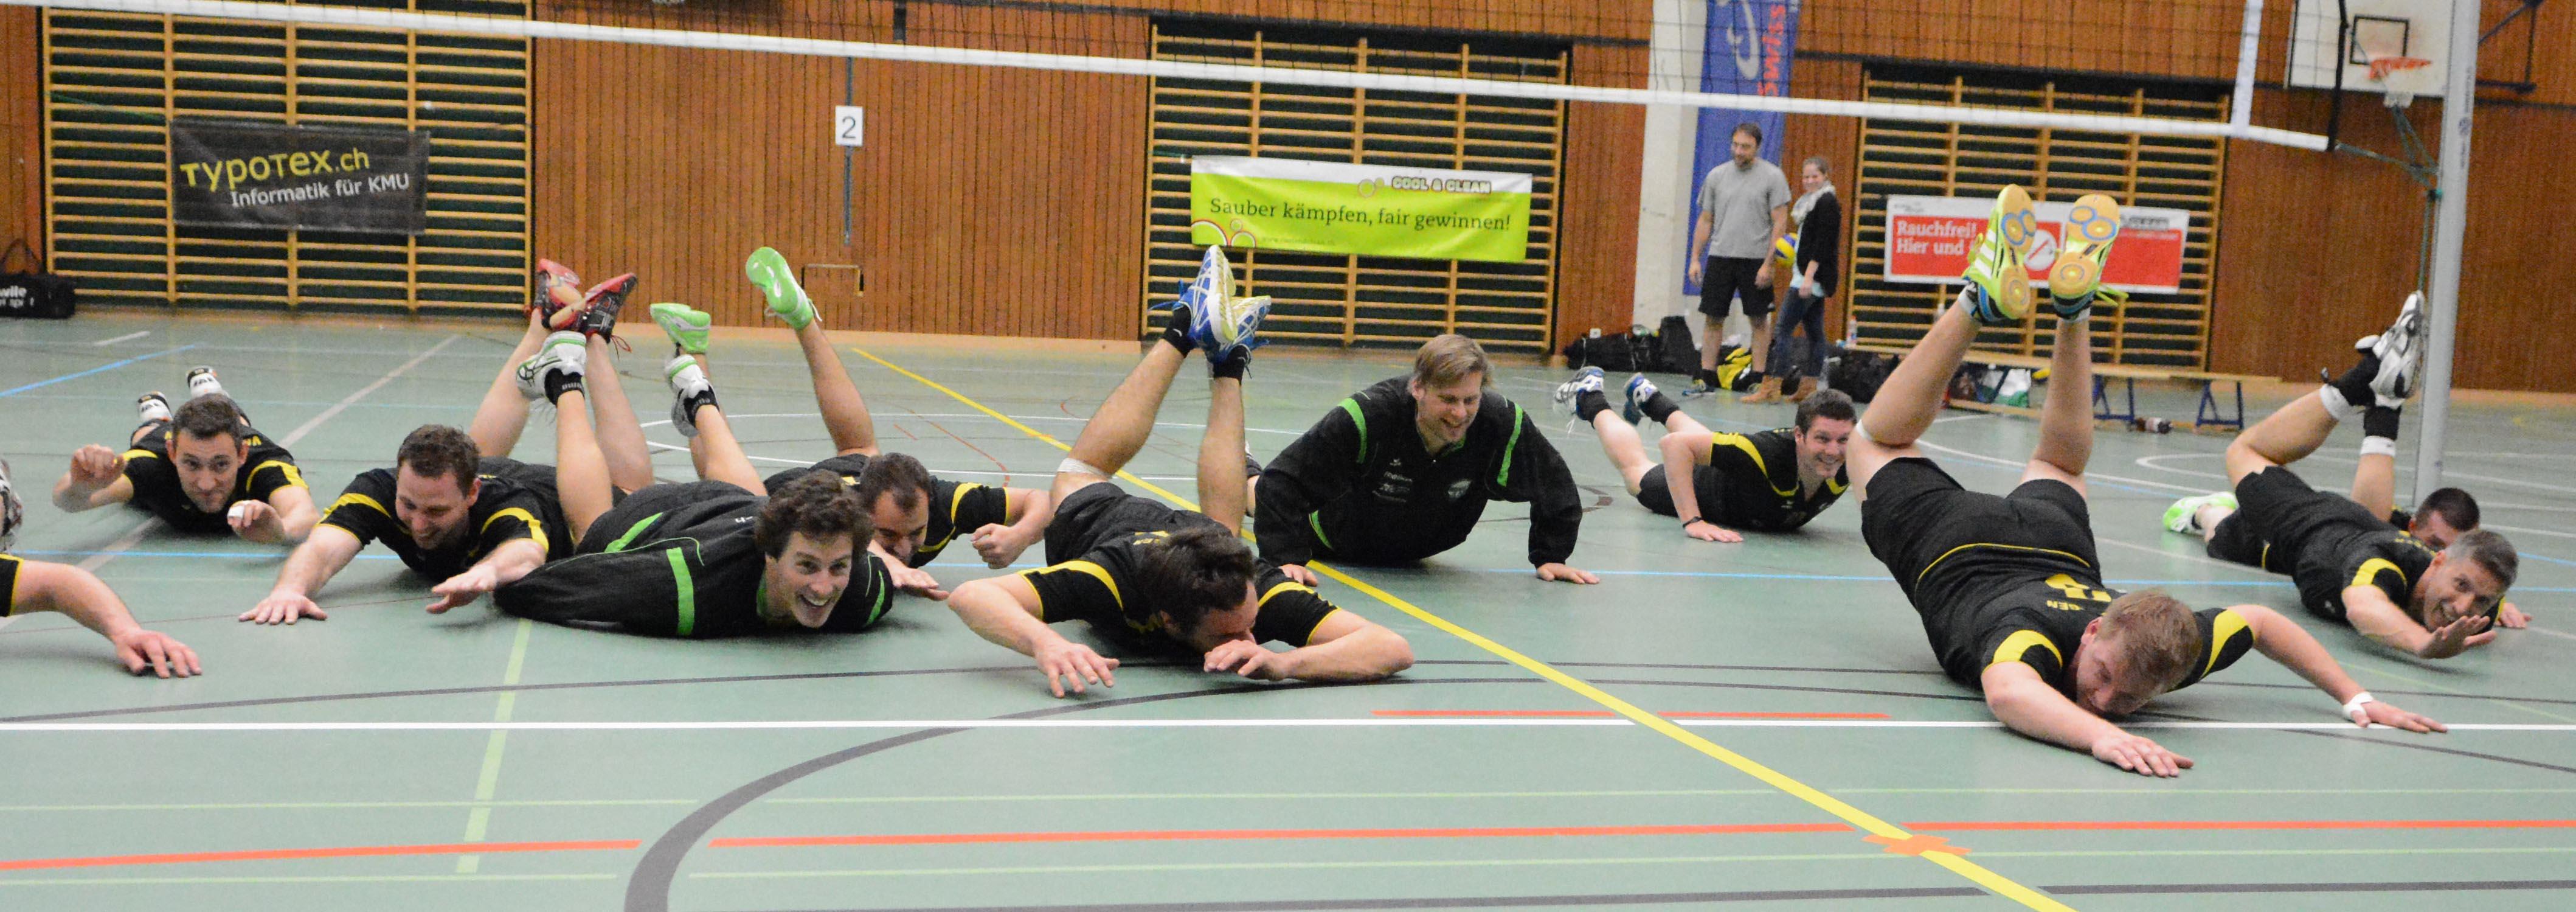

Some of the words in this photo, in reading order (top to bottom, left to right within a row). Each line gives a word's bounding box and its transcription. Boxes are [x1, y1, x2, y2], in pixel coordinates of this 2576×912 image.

[842, 116, 856, 139] 2
[230, 182, 330, 207] Informatik
[335, 179, 362, 197] für
[367, 172, 409, 193] KMU
[1392, 176, 1429, 191] COOL
[1445, 179, 1492, 194] CLEAN
[1211, 198, 1276, 217] Sauber
[1283, 201, 1373, 226] kämpfen,
[1379, 207, 1410, 225] fair
[1414, 212, 1511, 231] gewinnen!
[1897, 220, 1978, 238] Rauchfrei!
[1896, 238, 1929, 254] Hier
[1933, 239, 1965, 256] und
